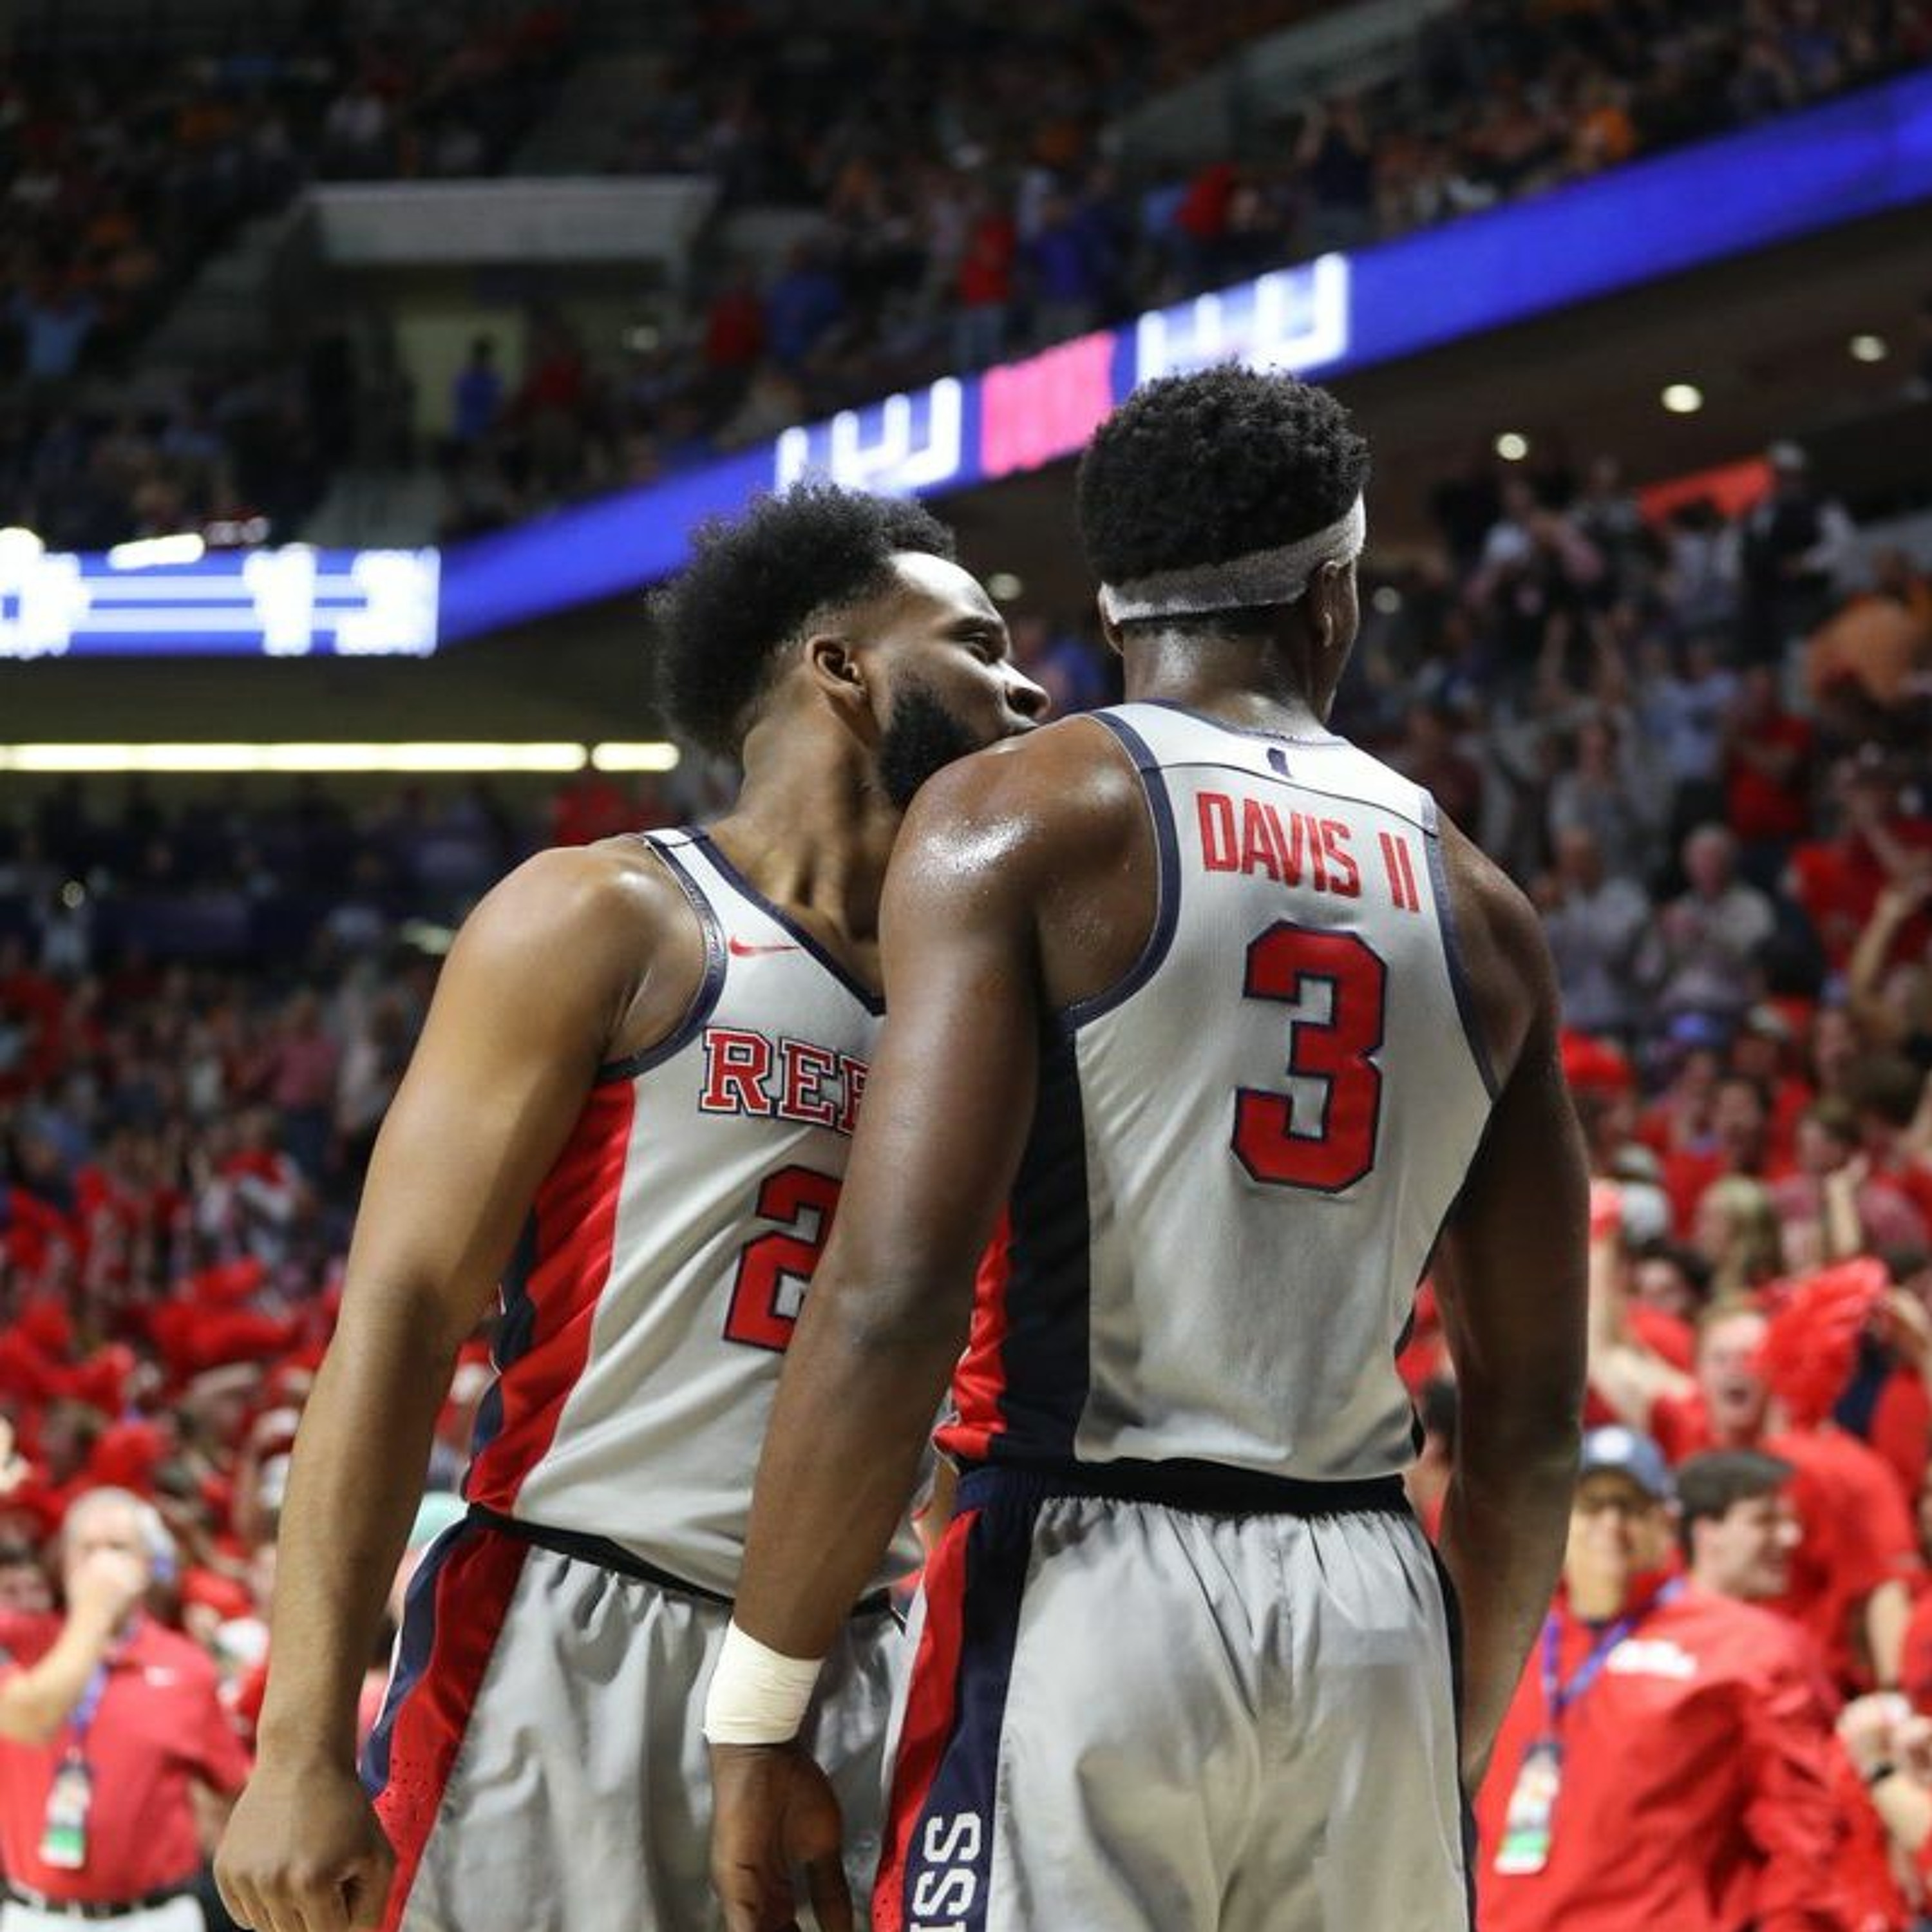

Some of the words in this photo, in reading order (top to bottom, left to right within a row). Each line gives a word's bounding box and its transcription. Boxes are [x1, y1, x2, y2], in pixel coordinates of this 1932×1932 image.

[1196, 791, 1362, 899] DAVIS
[1379, 831, 1421, 914] II
[1229, 918, 1388, 1195] 3
[722, 1164, 844, 1355] 2
